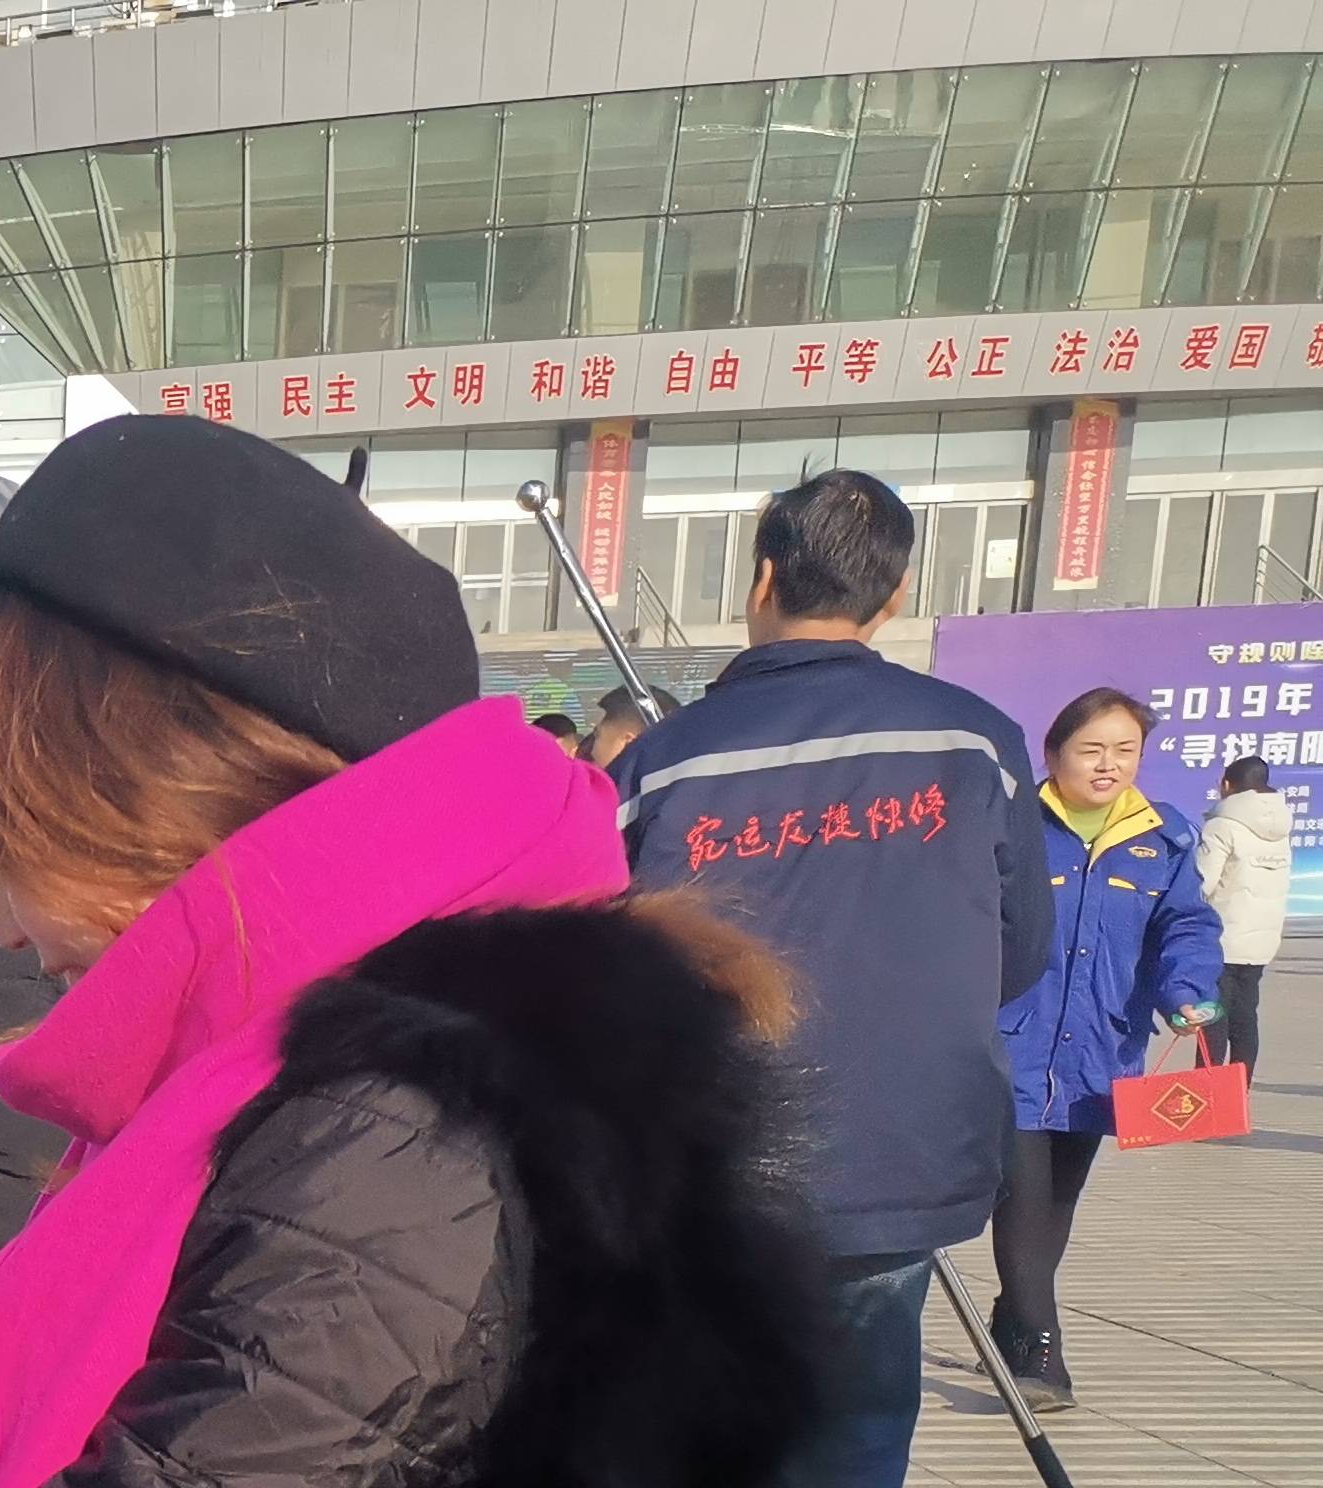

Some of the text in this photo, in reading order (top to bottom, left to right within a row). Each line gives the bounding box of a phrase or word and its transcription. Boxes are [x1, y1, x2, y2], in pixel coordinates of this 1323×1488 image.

[160, 383, 233, 421] 富强
[283, 373, 356, 417] 民主
[405, 363, 485, 408] 文明
[532, 356, 617, 402] 和谐
[666, 349, 740, 394] 自由
[791, 339, 880, 388] 平等
[926, 336, 1010, 380] 公正
[1050, 328, 1140, 376] 法治
[1180, 325, 1269, 371] 爱国
[1149, 683, 1313, 721] 2019年
